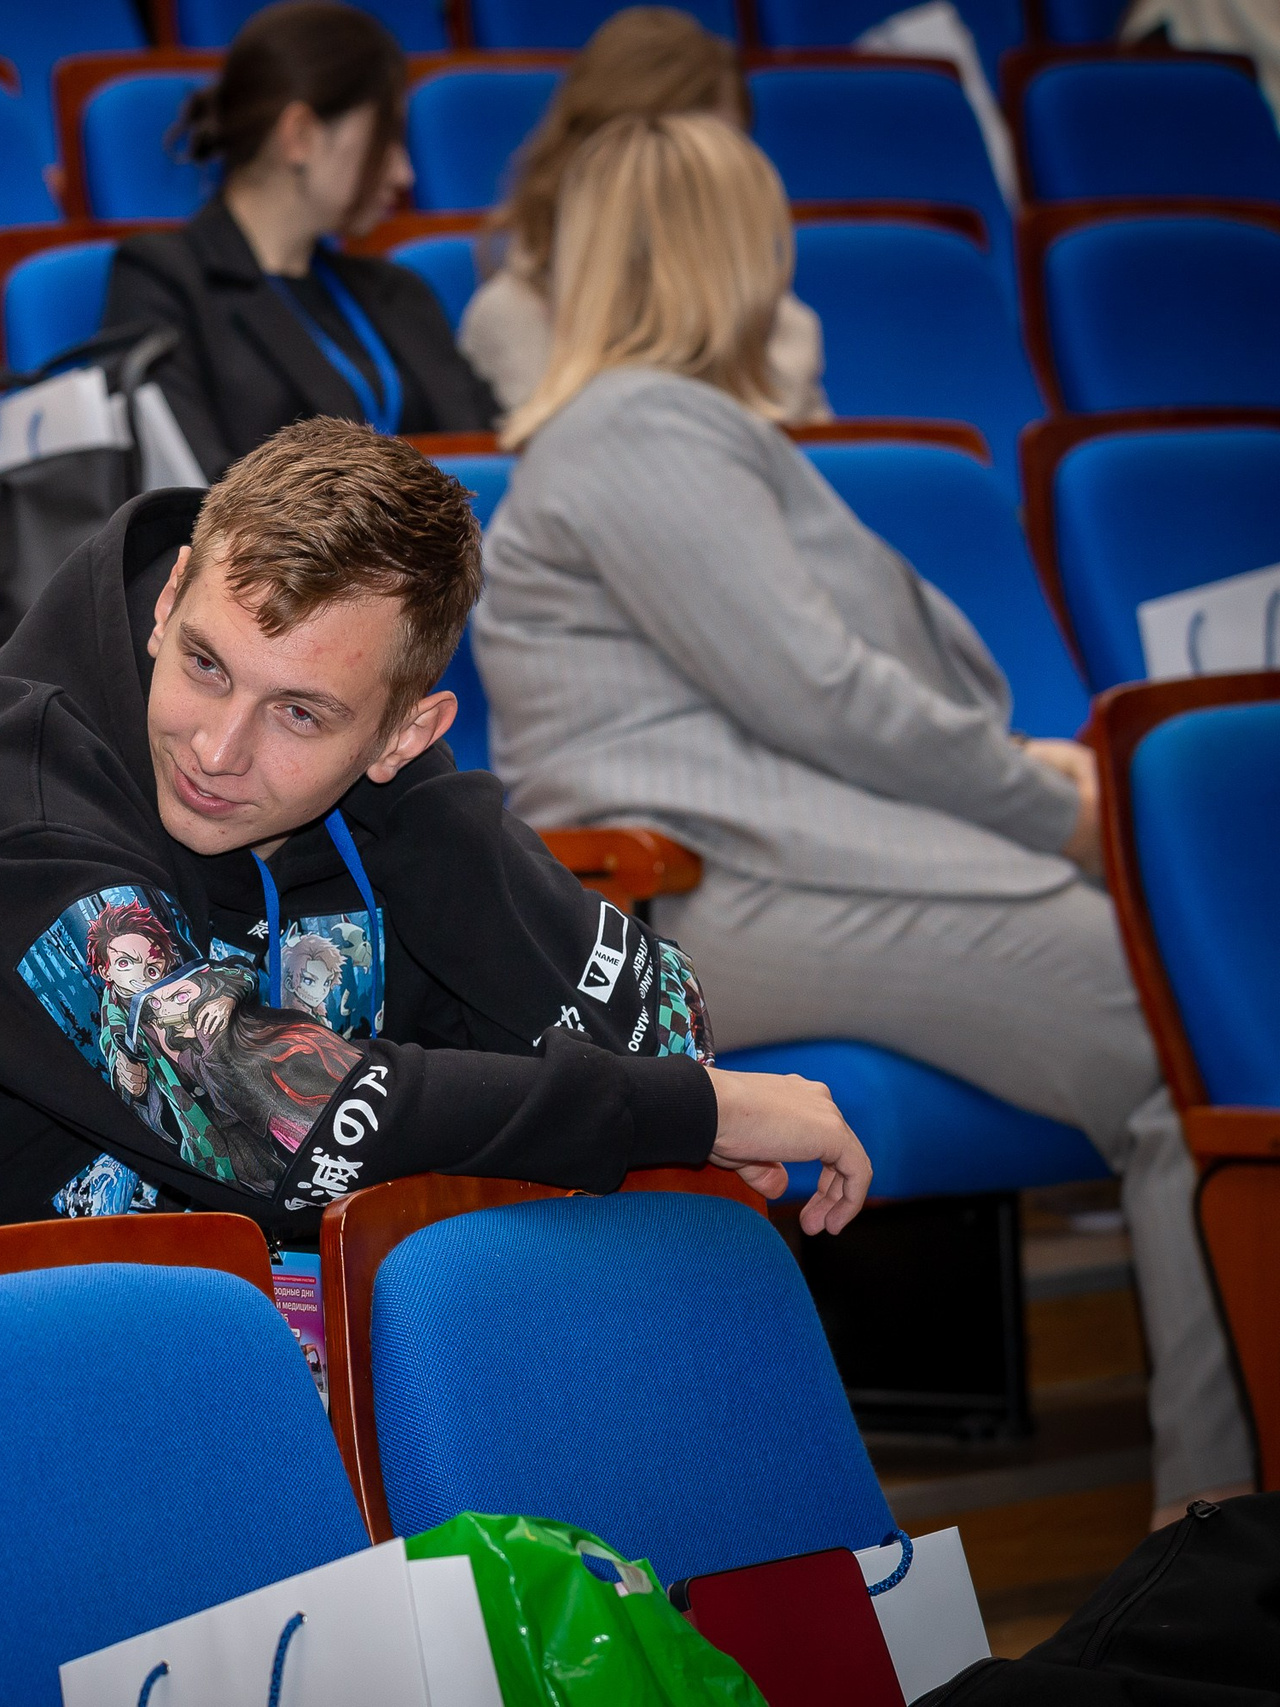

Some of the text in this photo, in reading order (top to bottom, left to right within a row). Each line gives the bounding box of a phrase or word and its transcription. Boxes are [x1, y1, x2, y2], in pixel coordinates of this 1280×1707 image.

[594, 950, 620, 967] NAME
[301, 1288, 314, 1298] дни
[282, 1301, 317, 1312] медицины
